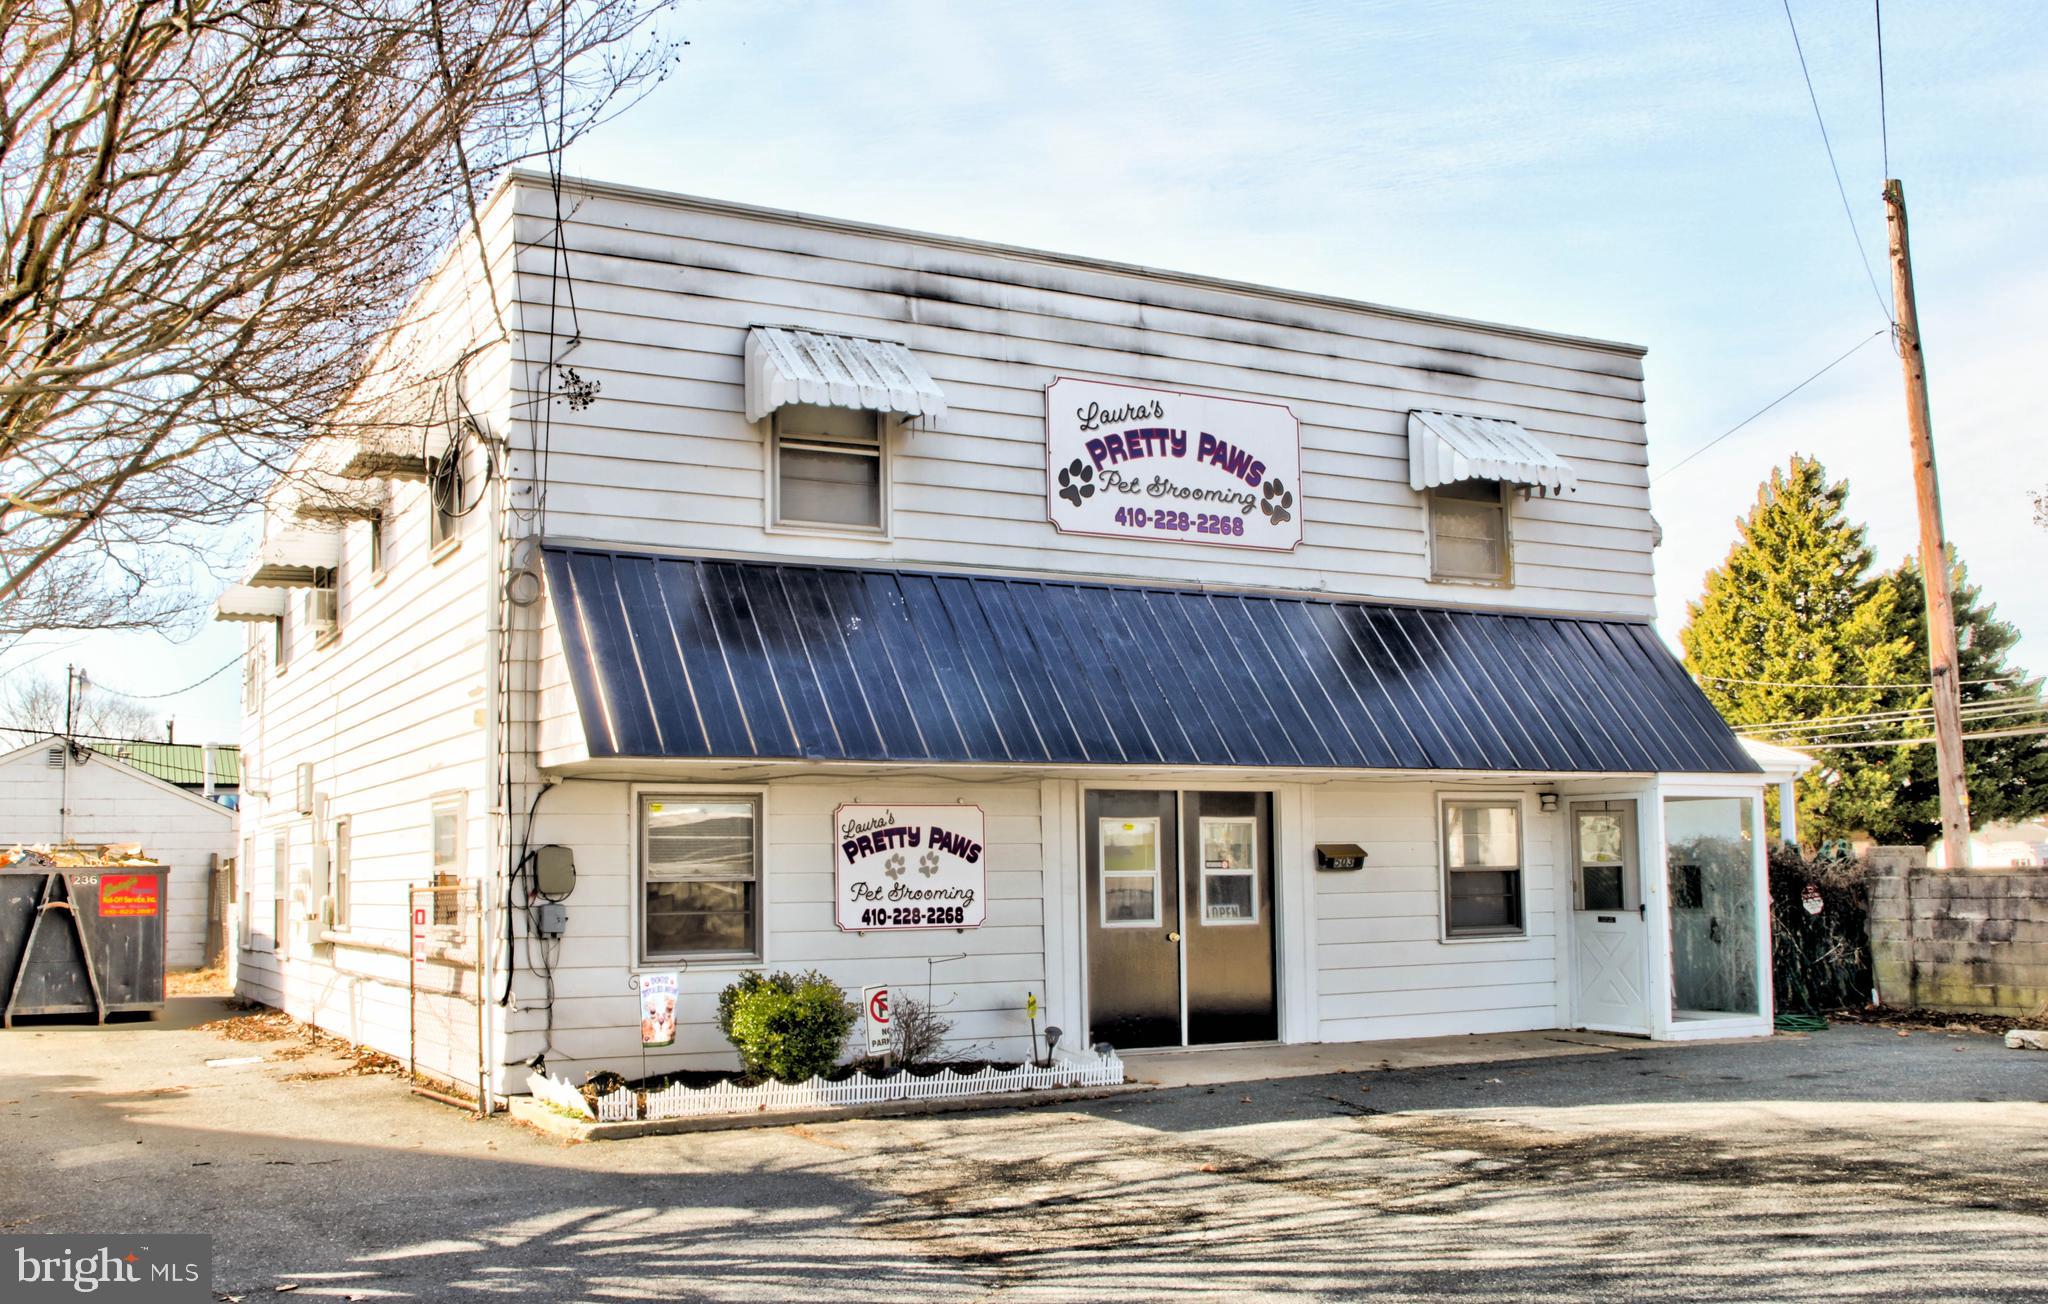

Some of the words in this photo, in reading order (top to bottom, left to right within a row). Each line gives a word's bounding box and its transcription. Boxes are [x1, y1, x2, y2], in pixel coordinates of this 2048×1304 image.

[1077, 400, 1164, 431] Laura's
[1085, 428, 1187, 472] PRETTY
[1197, 431, 1266, 488] PAWS
[1099, 470, 1141, 493] Pet
[1146, 475, 1258, 515] Grooming
[1114, 506, 1244, 537] 410-228-2268
[842, 809, 895, 840] Laura's
[842, 826, 921, 864] PRETTY
[928, 826, 982, 864] PAWS
[73, 875, 98, 885] 236
[850, 881, 883, 902] Pet
[888, 882, 975, 908] Grooming
[861, 906, 964, 926] 410-228-2268
[1212, 906, 1239, 918] OPEN
